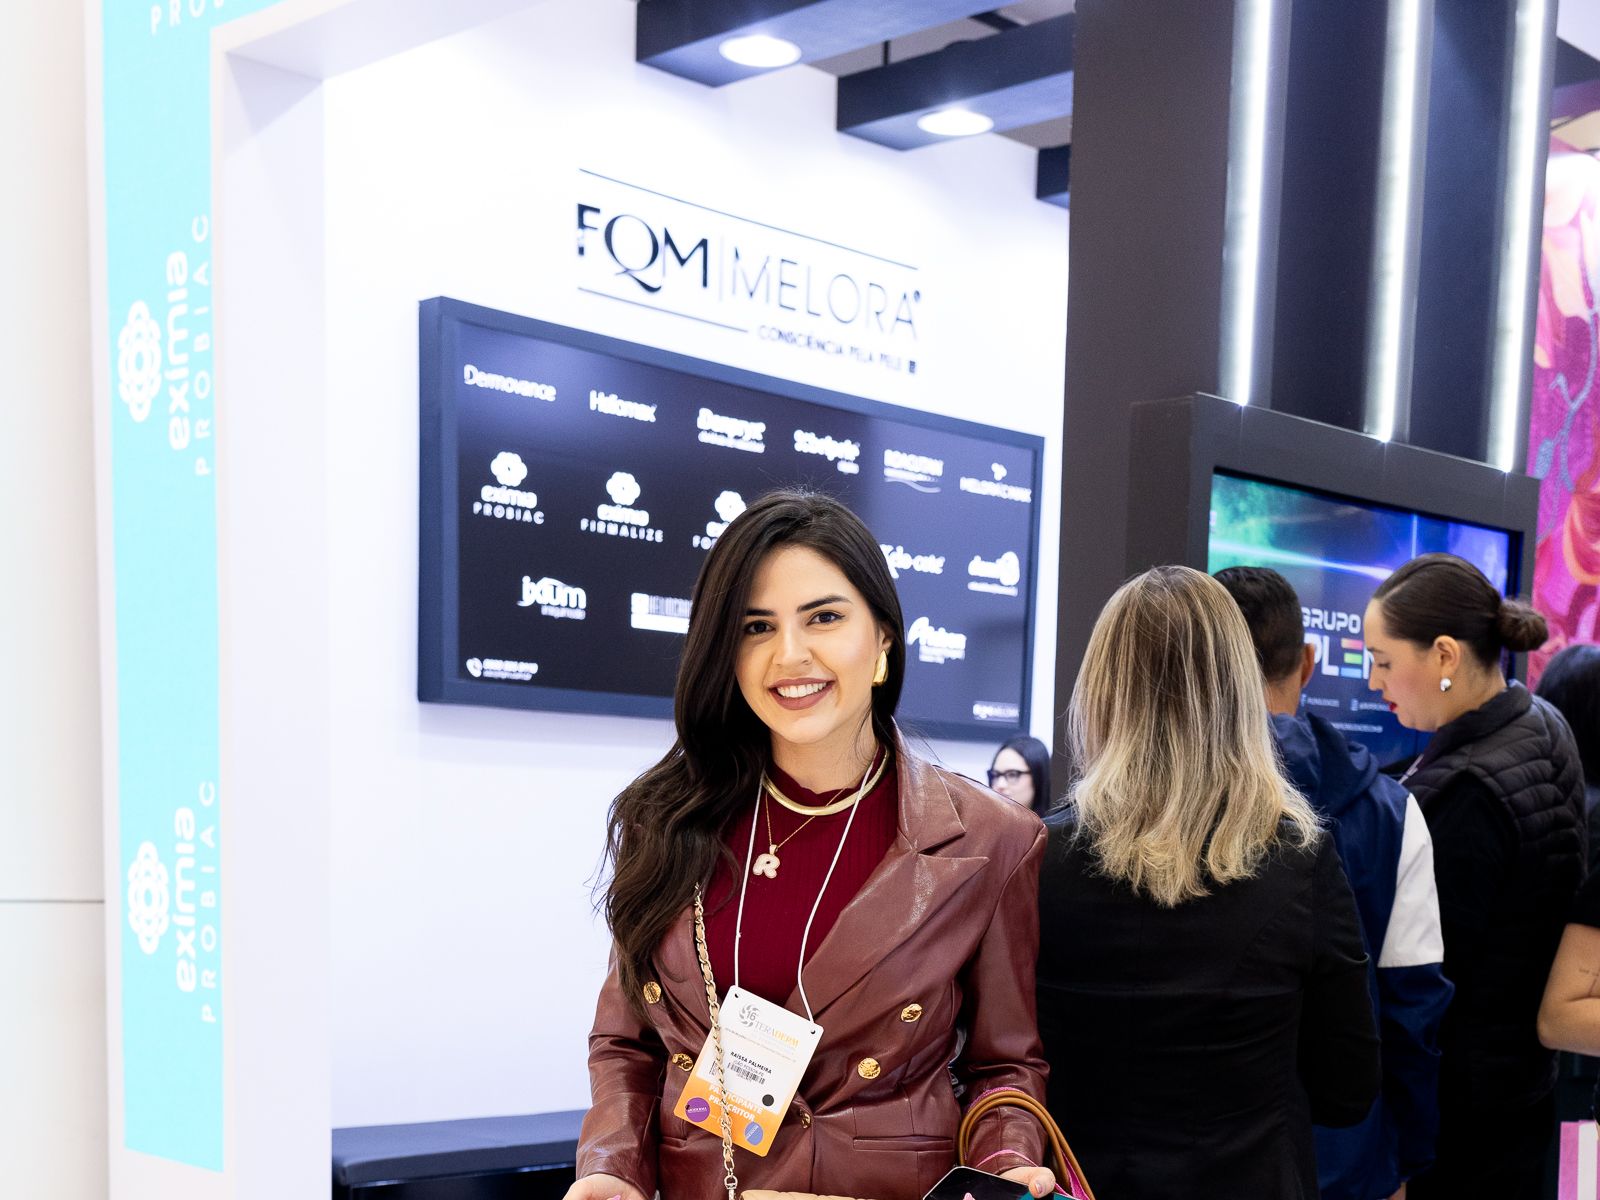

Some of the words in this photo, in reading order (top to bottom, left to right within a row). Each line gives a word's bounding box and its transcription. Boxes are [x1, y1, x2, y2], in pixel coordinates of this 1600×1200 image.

[577, 203, 709, 294] FQM
[191, 214, 211, 476] PROBIAC
[473, 501, 545, 525] PROBIAC
[580, 518, 664, 543] FIRMALIZE
[199, 781, 217, 1024] PROBIAC
